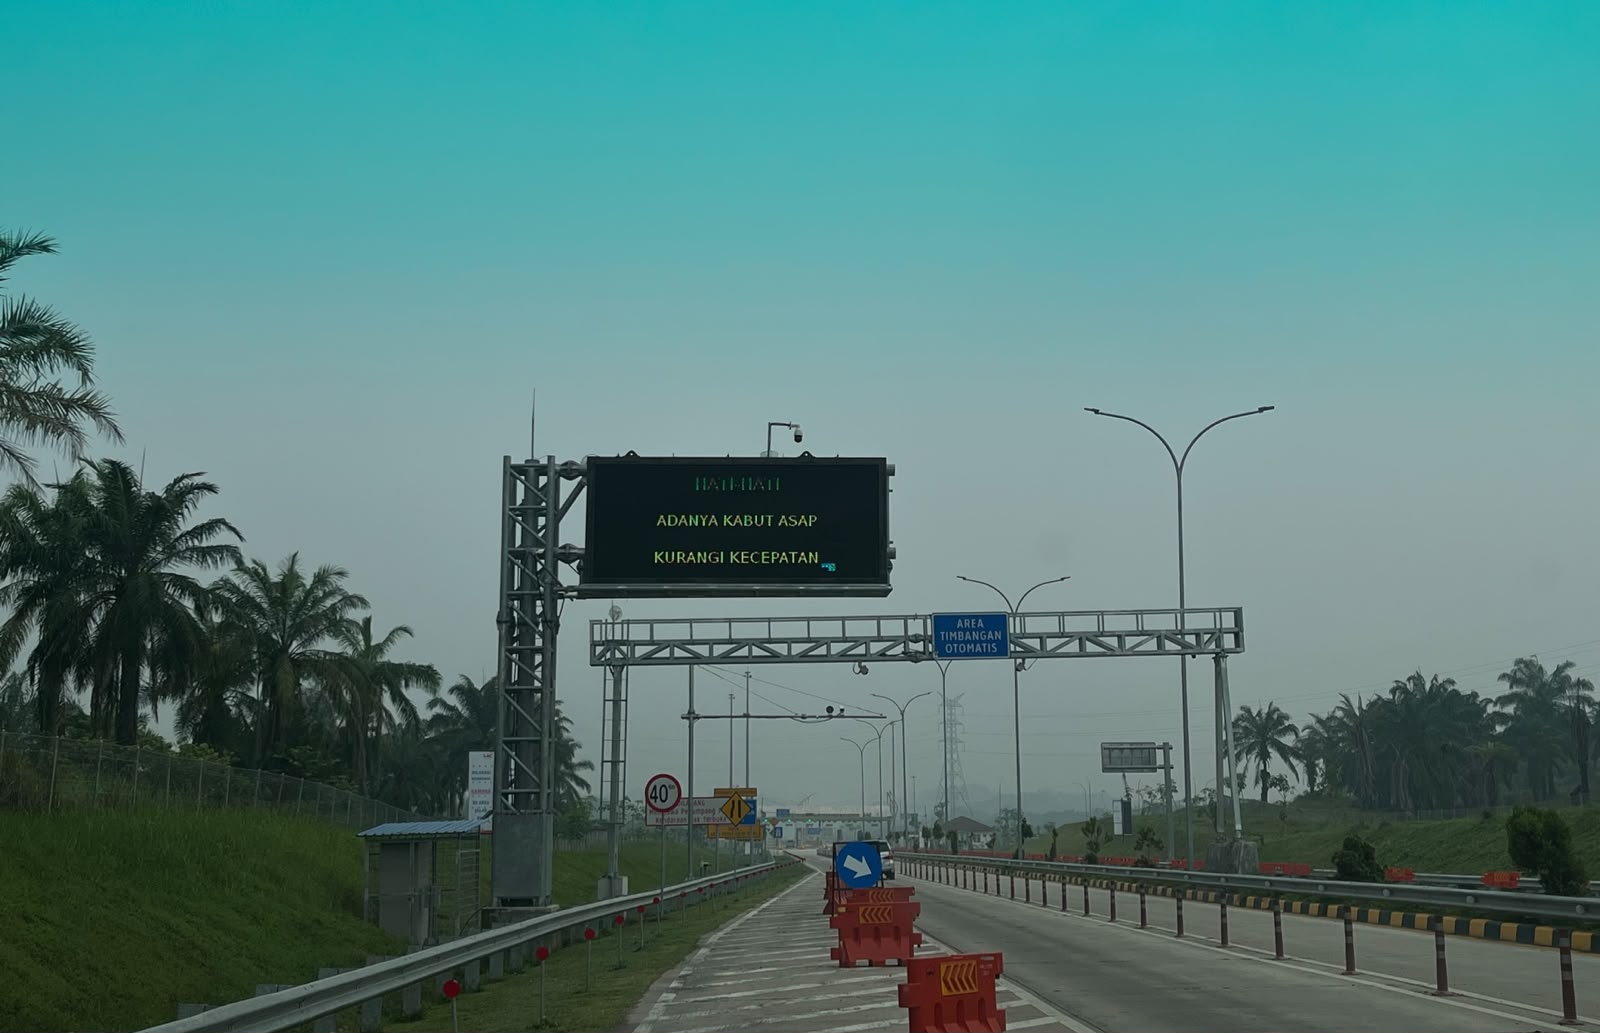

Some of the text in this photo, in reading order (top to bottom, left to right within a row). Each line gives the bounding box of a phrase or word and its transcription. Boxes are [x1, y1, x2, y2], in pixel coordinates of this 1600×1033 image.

[656, 514, 818, 527] ADANYA KABUT ASAP
[654, 551, 819, 564] KURANGI KECEPATAN
[956, 618, 985, 629] AREA
[940, 630, 1002, 641] TIMBANGAN
[945, 643, 998, 654] OTOMATIS
[650, 783, 669, 804] 40
